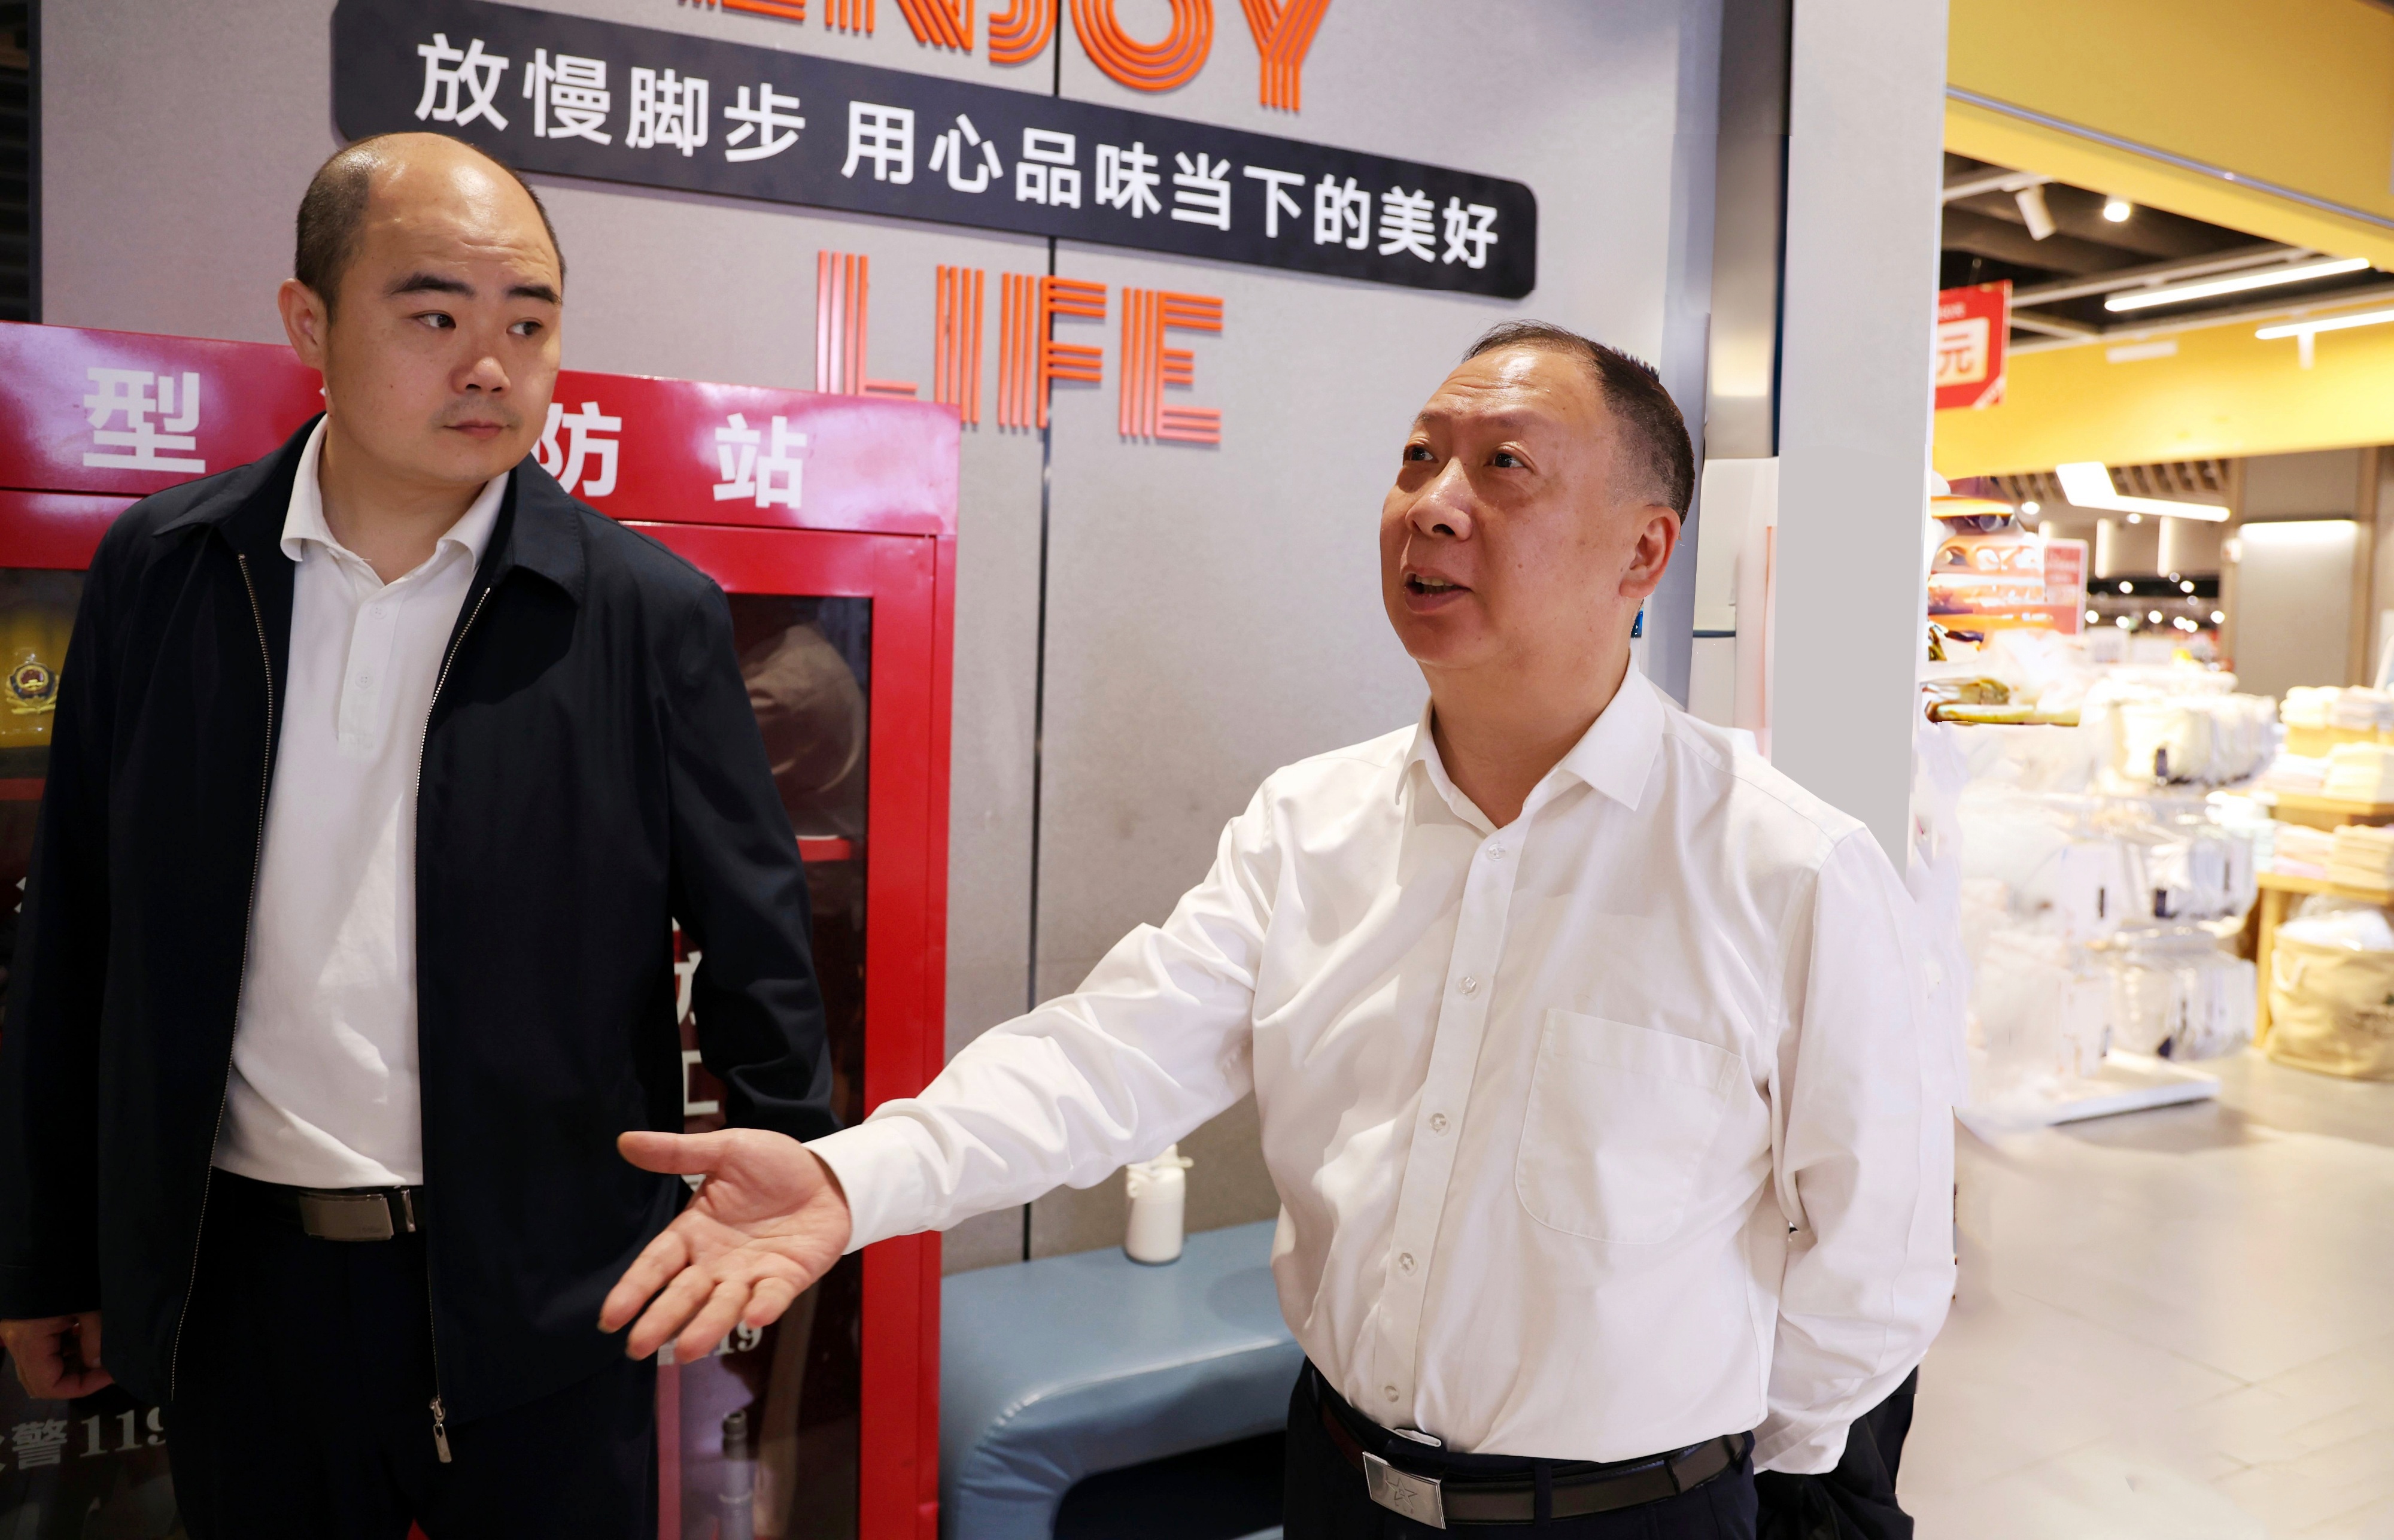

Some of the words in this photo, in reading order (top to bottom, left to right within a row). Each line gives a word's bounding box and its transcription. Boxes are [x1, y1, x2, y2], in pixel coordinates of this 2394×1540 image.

[414, 32, 806, 163] 放慢脚步
[841, 100, 1499, 269] 用心品味当下的美好
[816, 250, 1224, 443] LIFE
